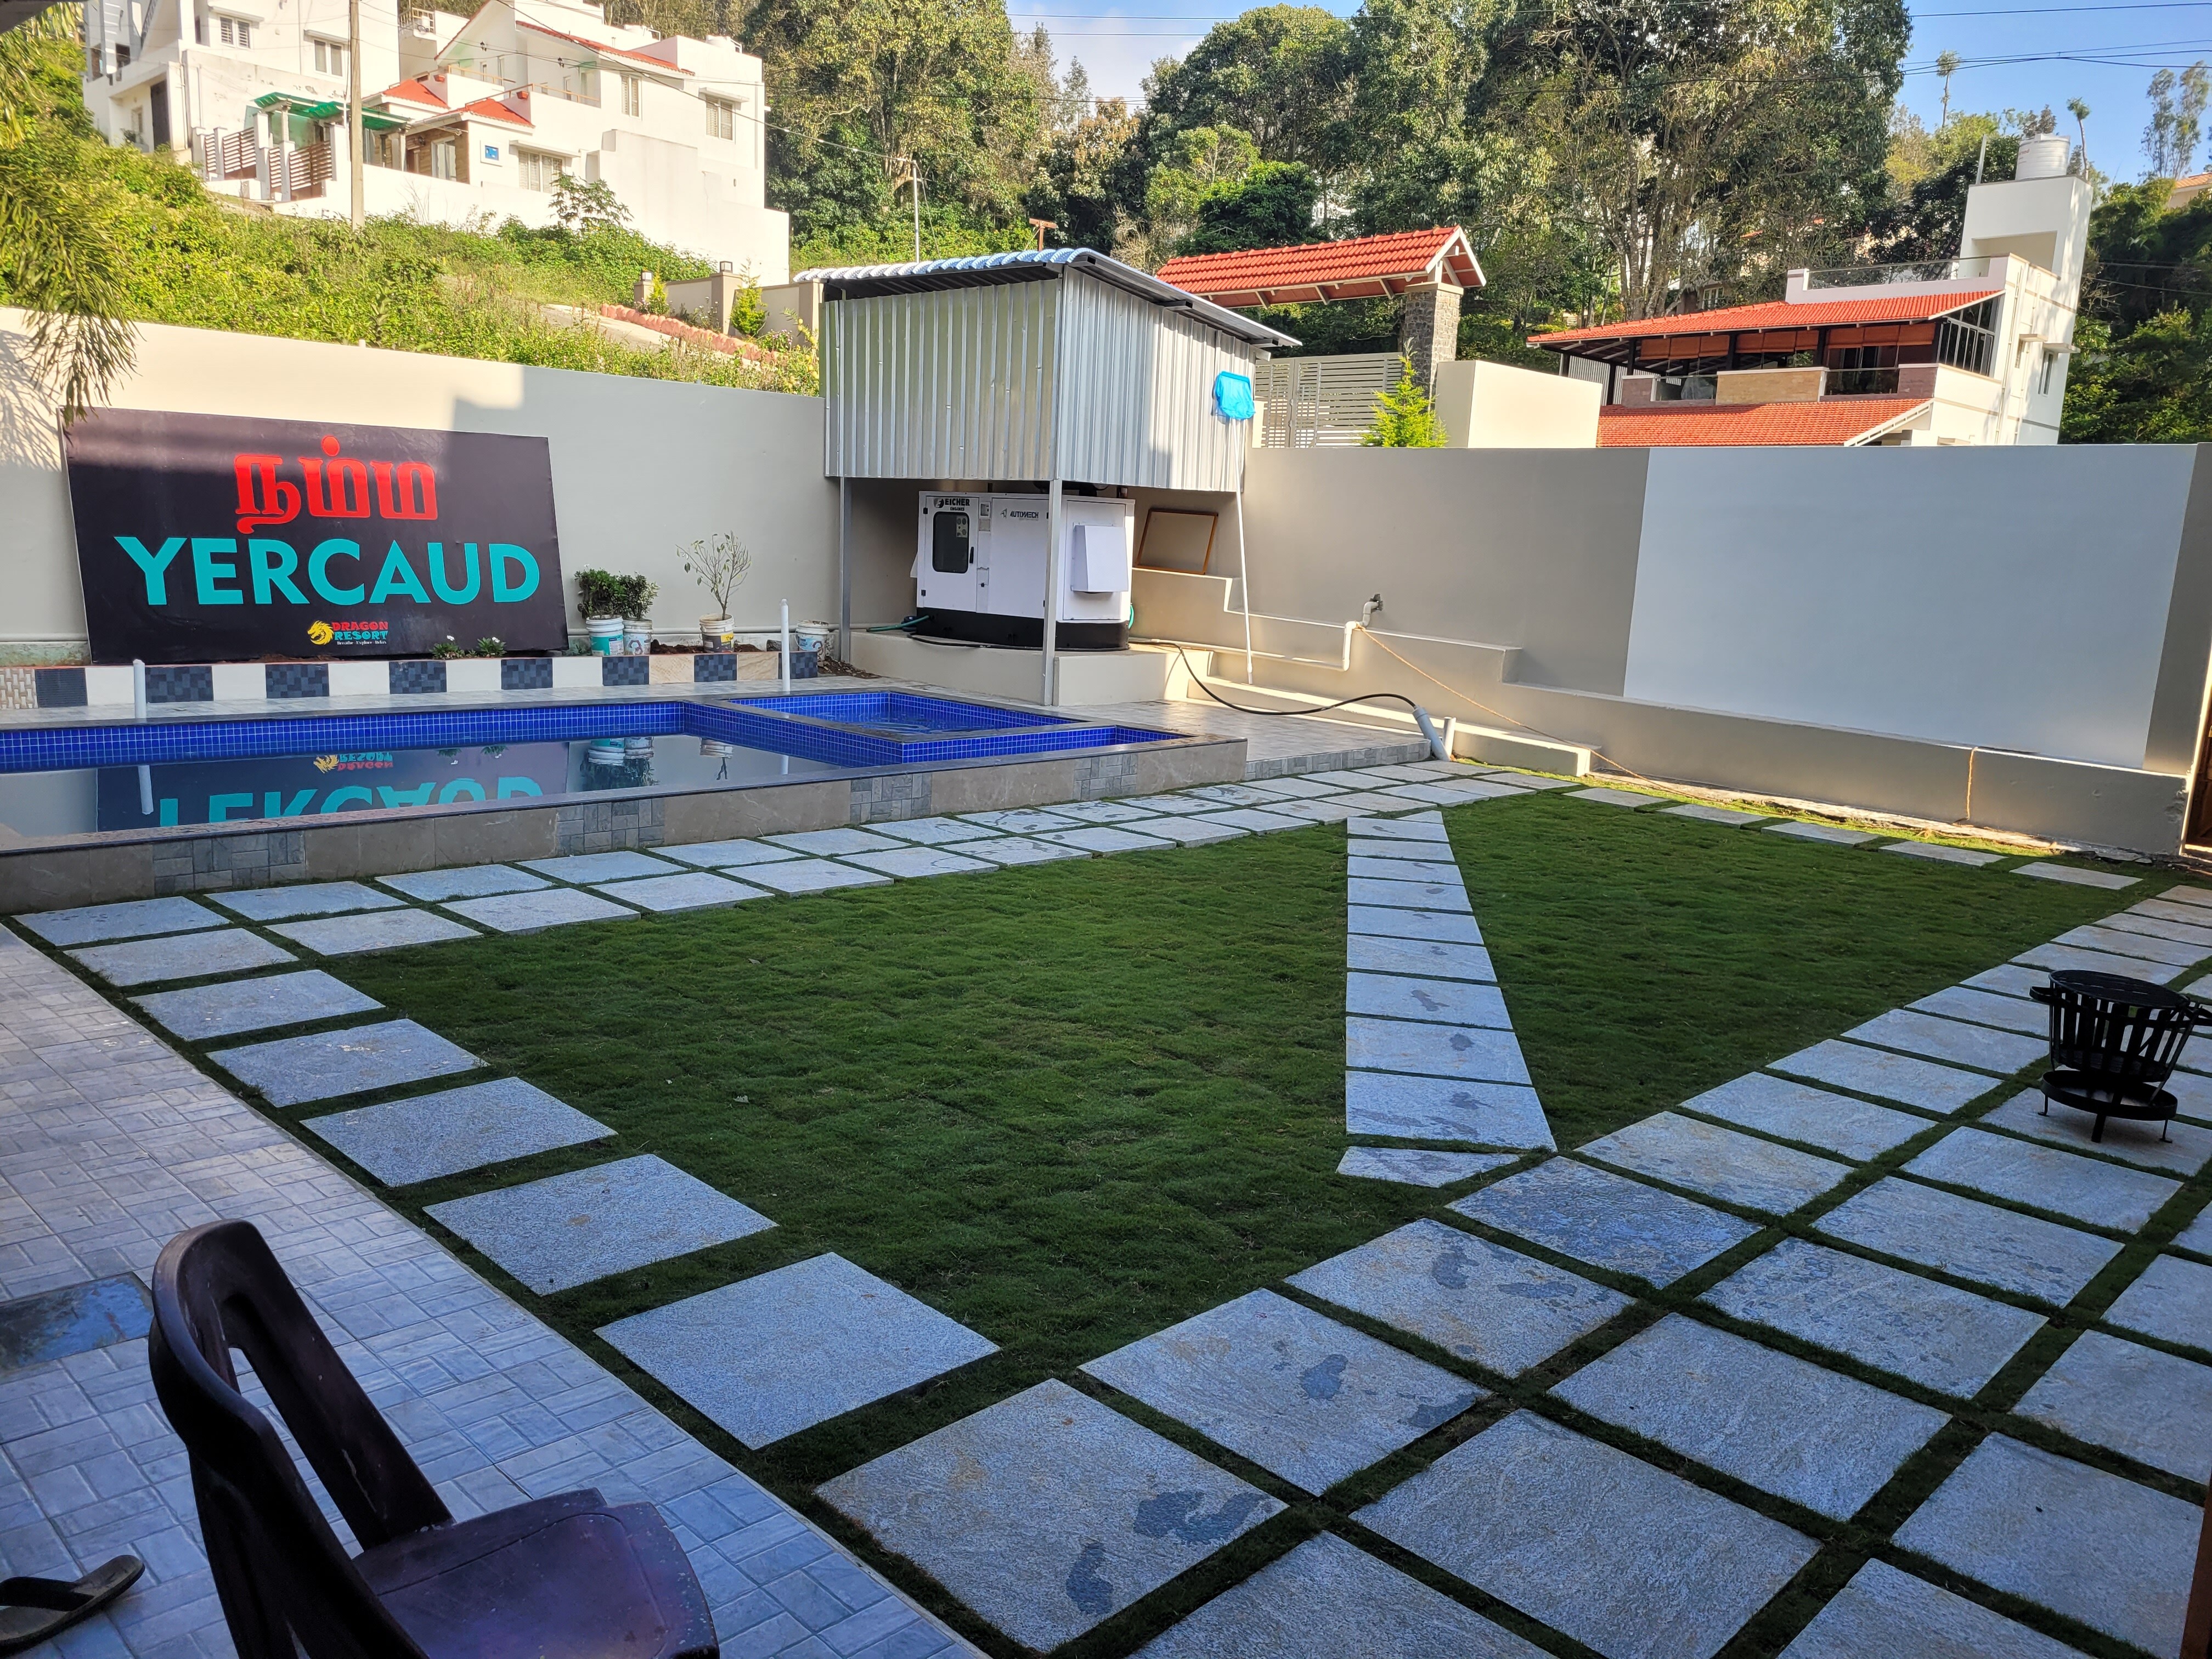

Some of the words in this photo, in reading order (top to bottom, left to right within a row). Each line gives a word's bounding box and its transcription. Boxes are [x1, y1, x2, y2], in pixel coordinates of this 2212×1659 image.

[234, 435, 438, 534] நம்ம
[945, 498, 970, 506] EICHER
[1009, 510, 1039, 518] AUTOMECH
[115, 535, 540, 606] YERCAUD
[331, 622, 388, 631] DRAGON
[334, 630, 389, 640] RESORT
